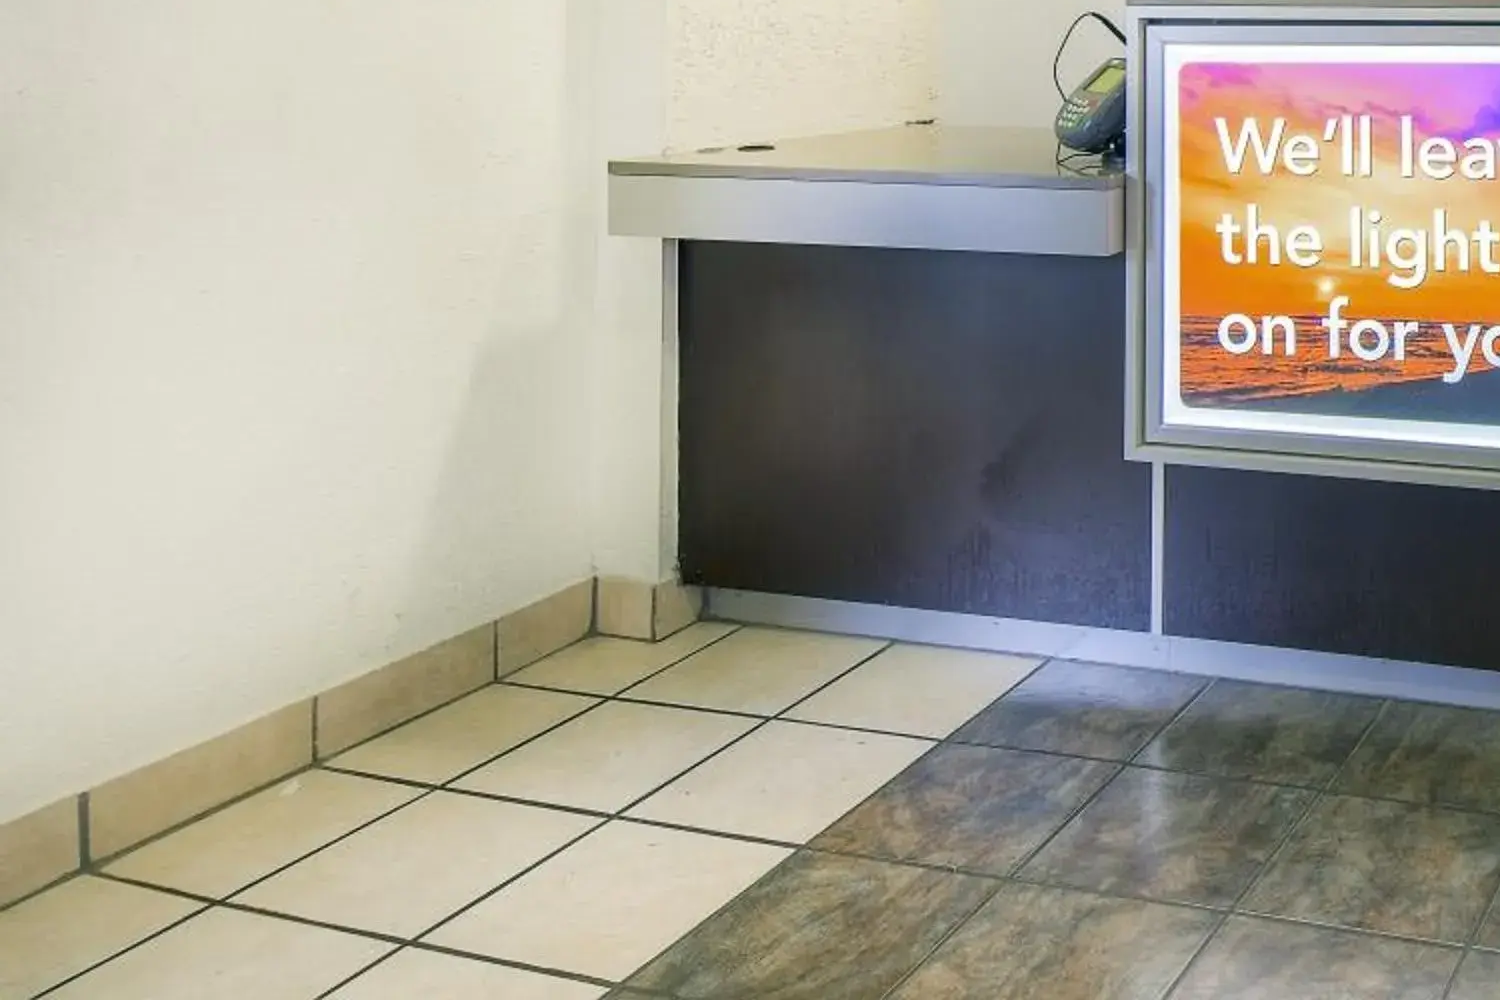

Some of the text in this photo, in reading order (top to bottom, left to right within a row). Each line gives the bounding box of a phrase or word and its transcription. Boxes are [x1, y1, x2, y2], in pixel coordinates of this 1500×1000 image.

[1216, 204, 1323, 267] the
[1217, 312, 1297, 356] on
[1321, 296, 1419, 362] for
